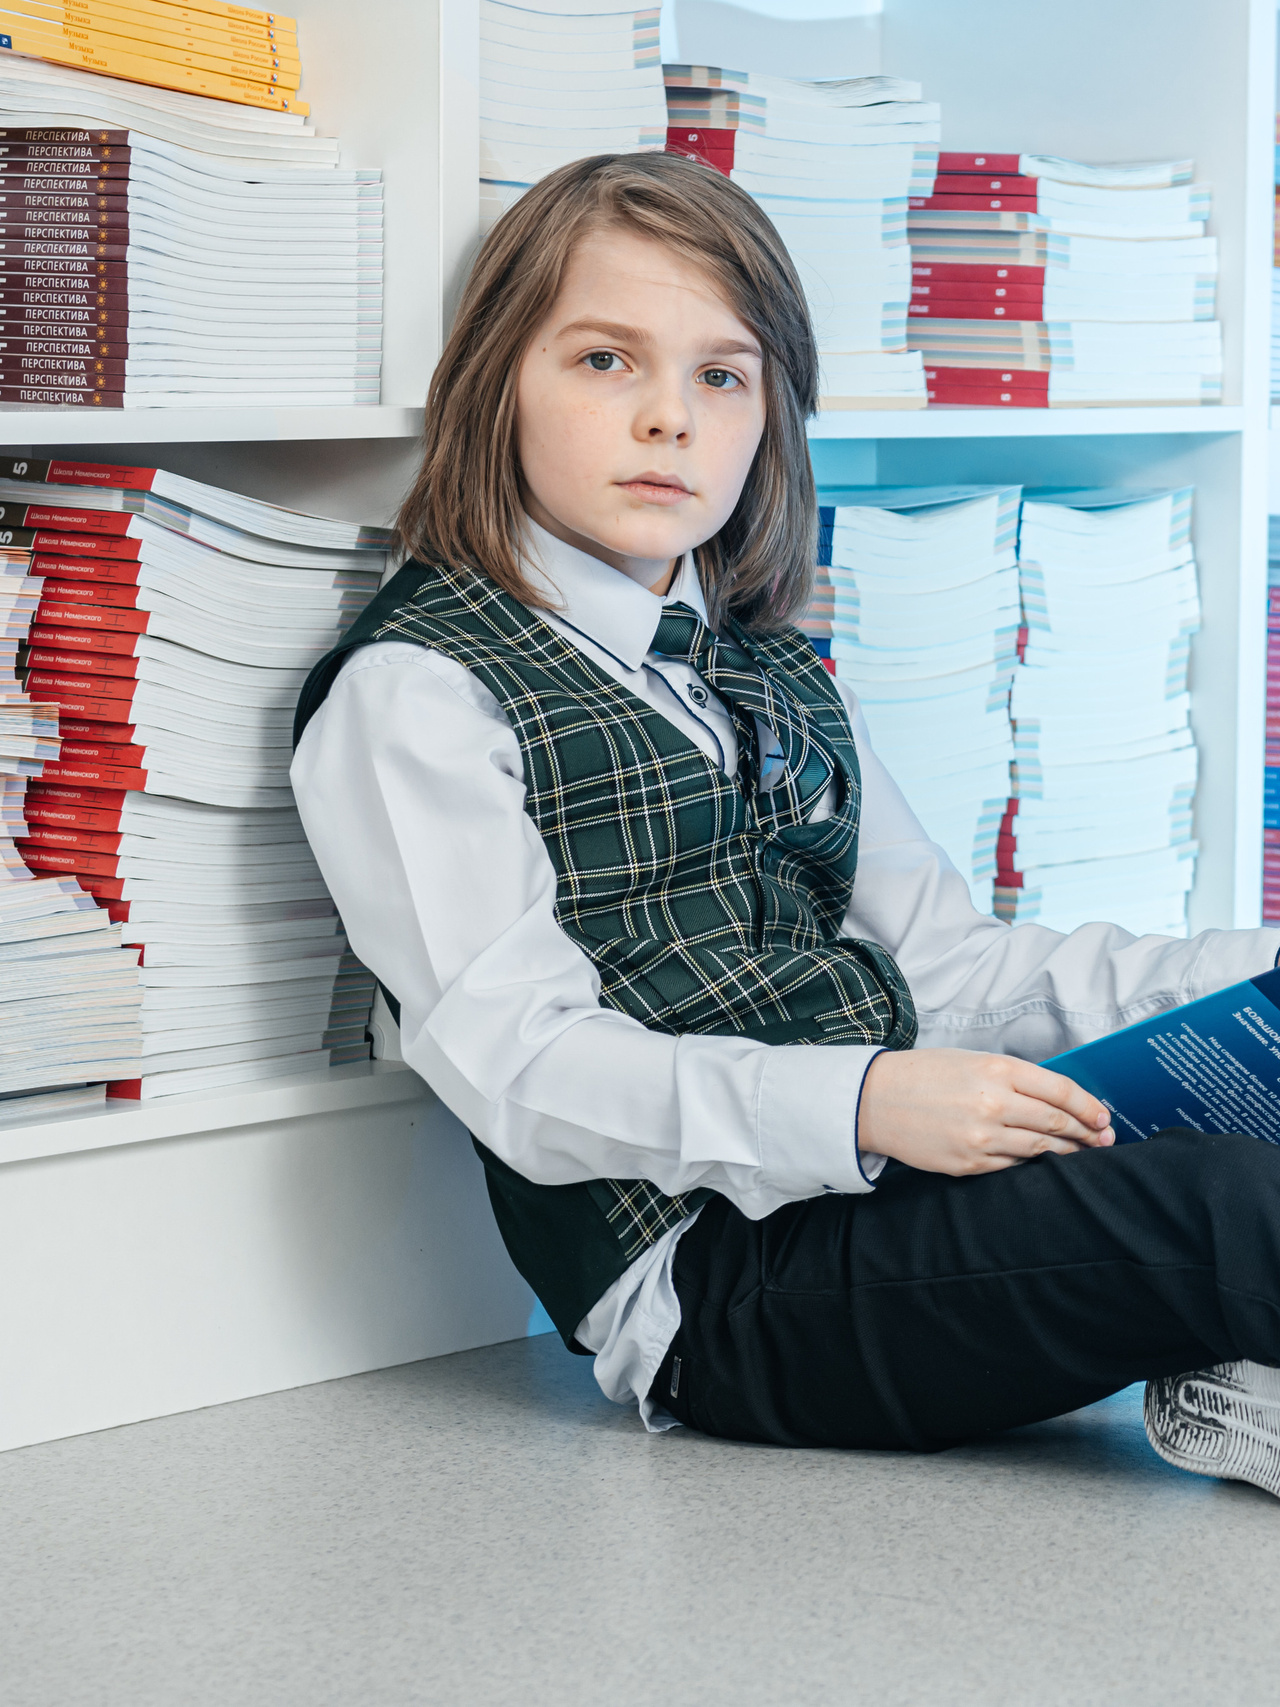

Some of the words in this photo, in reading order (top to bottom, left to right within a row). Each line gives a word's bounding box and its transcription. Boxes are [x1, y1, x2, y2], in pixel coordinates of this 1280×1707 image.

[64, 12, 91, 24] Музыка
[62, 27, 89, 40] Музыка
[69, 42, 94, 54] Музыка
[82, 55, 108, 67] Музыка
[25, 130, 90, 142] ПЕРСПЕКТИВА
[27, 146, 93, 157] ПЕРСПЕКТИВА
[26, 162, 91, 173] ПЕРСПЕКТИВА
[23, 178, 88, 190] ПЕРСПЕКТИВА
[25, 195, 89, 207] ПЕРСПЕКТИВА
[26, 211, 90, 223] ПЕРСПЕКТИВА
[24, 227, 90, 240] ПЕРСПЕКТИВА
[24, 243, 88, 254] ПЕРСПЕКТИВА
[24, 260, 89, 272] ПЕРСПЕКТИВА
[25, 276, 90, 289] ПЕРСПЕКТИВА
[23, 292, 88, 304] ПЕРСПЕКТИВА
[25, 308, 90, 321] ПЕРСПЕКТИВА
[23, 325, 88, 337] ПЕРСПЕКТИВА
[26, 341, 91, 354] ПЕРСПЕКТИВА
[21, 358, 86, 371] ПЕРСПЕКТИВА
[23, 373, 88, 386] ПЕРСПЕКТИВА
[20, 390, 84, 403] ПЕРСПЕКТИВА
[12, 461, 28, 476] 5
[53, 468, 74, 476] Школа
[74, 470, 111, 479] Неменского
[30, 512, 51, 521] Школа
[51, 514, 88, 524] Неменского
[38, 537, 59, 545] Школа
[60, 539, 96, 549] Неменского
[36, 561, 57, 570] Школа
[57, 563, 95, 574] Неменского
[56, 586, 94, 597] Неменского
[41, 609, 63, 618] Школа
[64, 611, 102, 622] Неменского
[33, 631, 54, 640] Школа
[55, 633, 92, 644] Неменского
[33, 654, 54, 662] Школа
[55, 656, 92, 666] Неменского
[32, 676, 53, 685] Школа
[54, 678, 91, 689] Неменского
[62, 746, 99, 756] Неменского
[61, 768, 100, 779] Неменского
[46, 788, 82, 799] Неменского
[40, 810, 76, 821] Неменского
[42, 831, 78, 842] Неменского
[39, 854, 75, 865] Неменского
[1231, 1010, 1269, 1047] Значение.
[1115, 1112, 1148, 1140] сочетаемо
